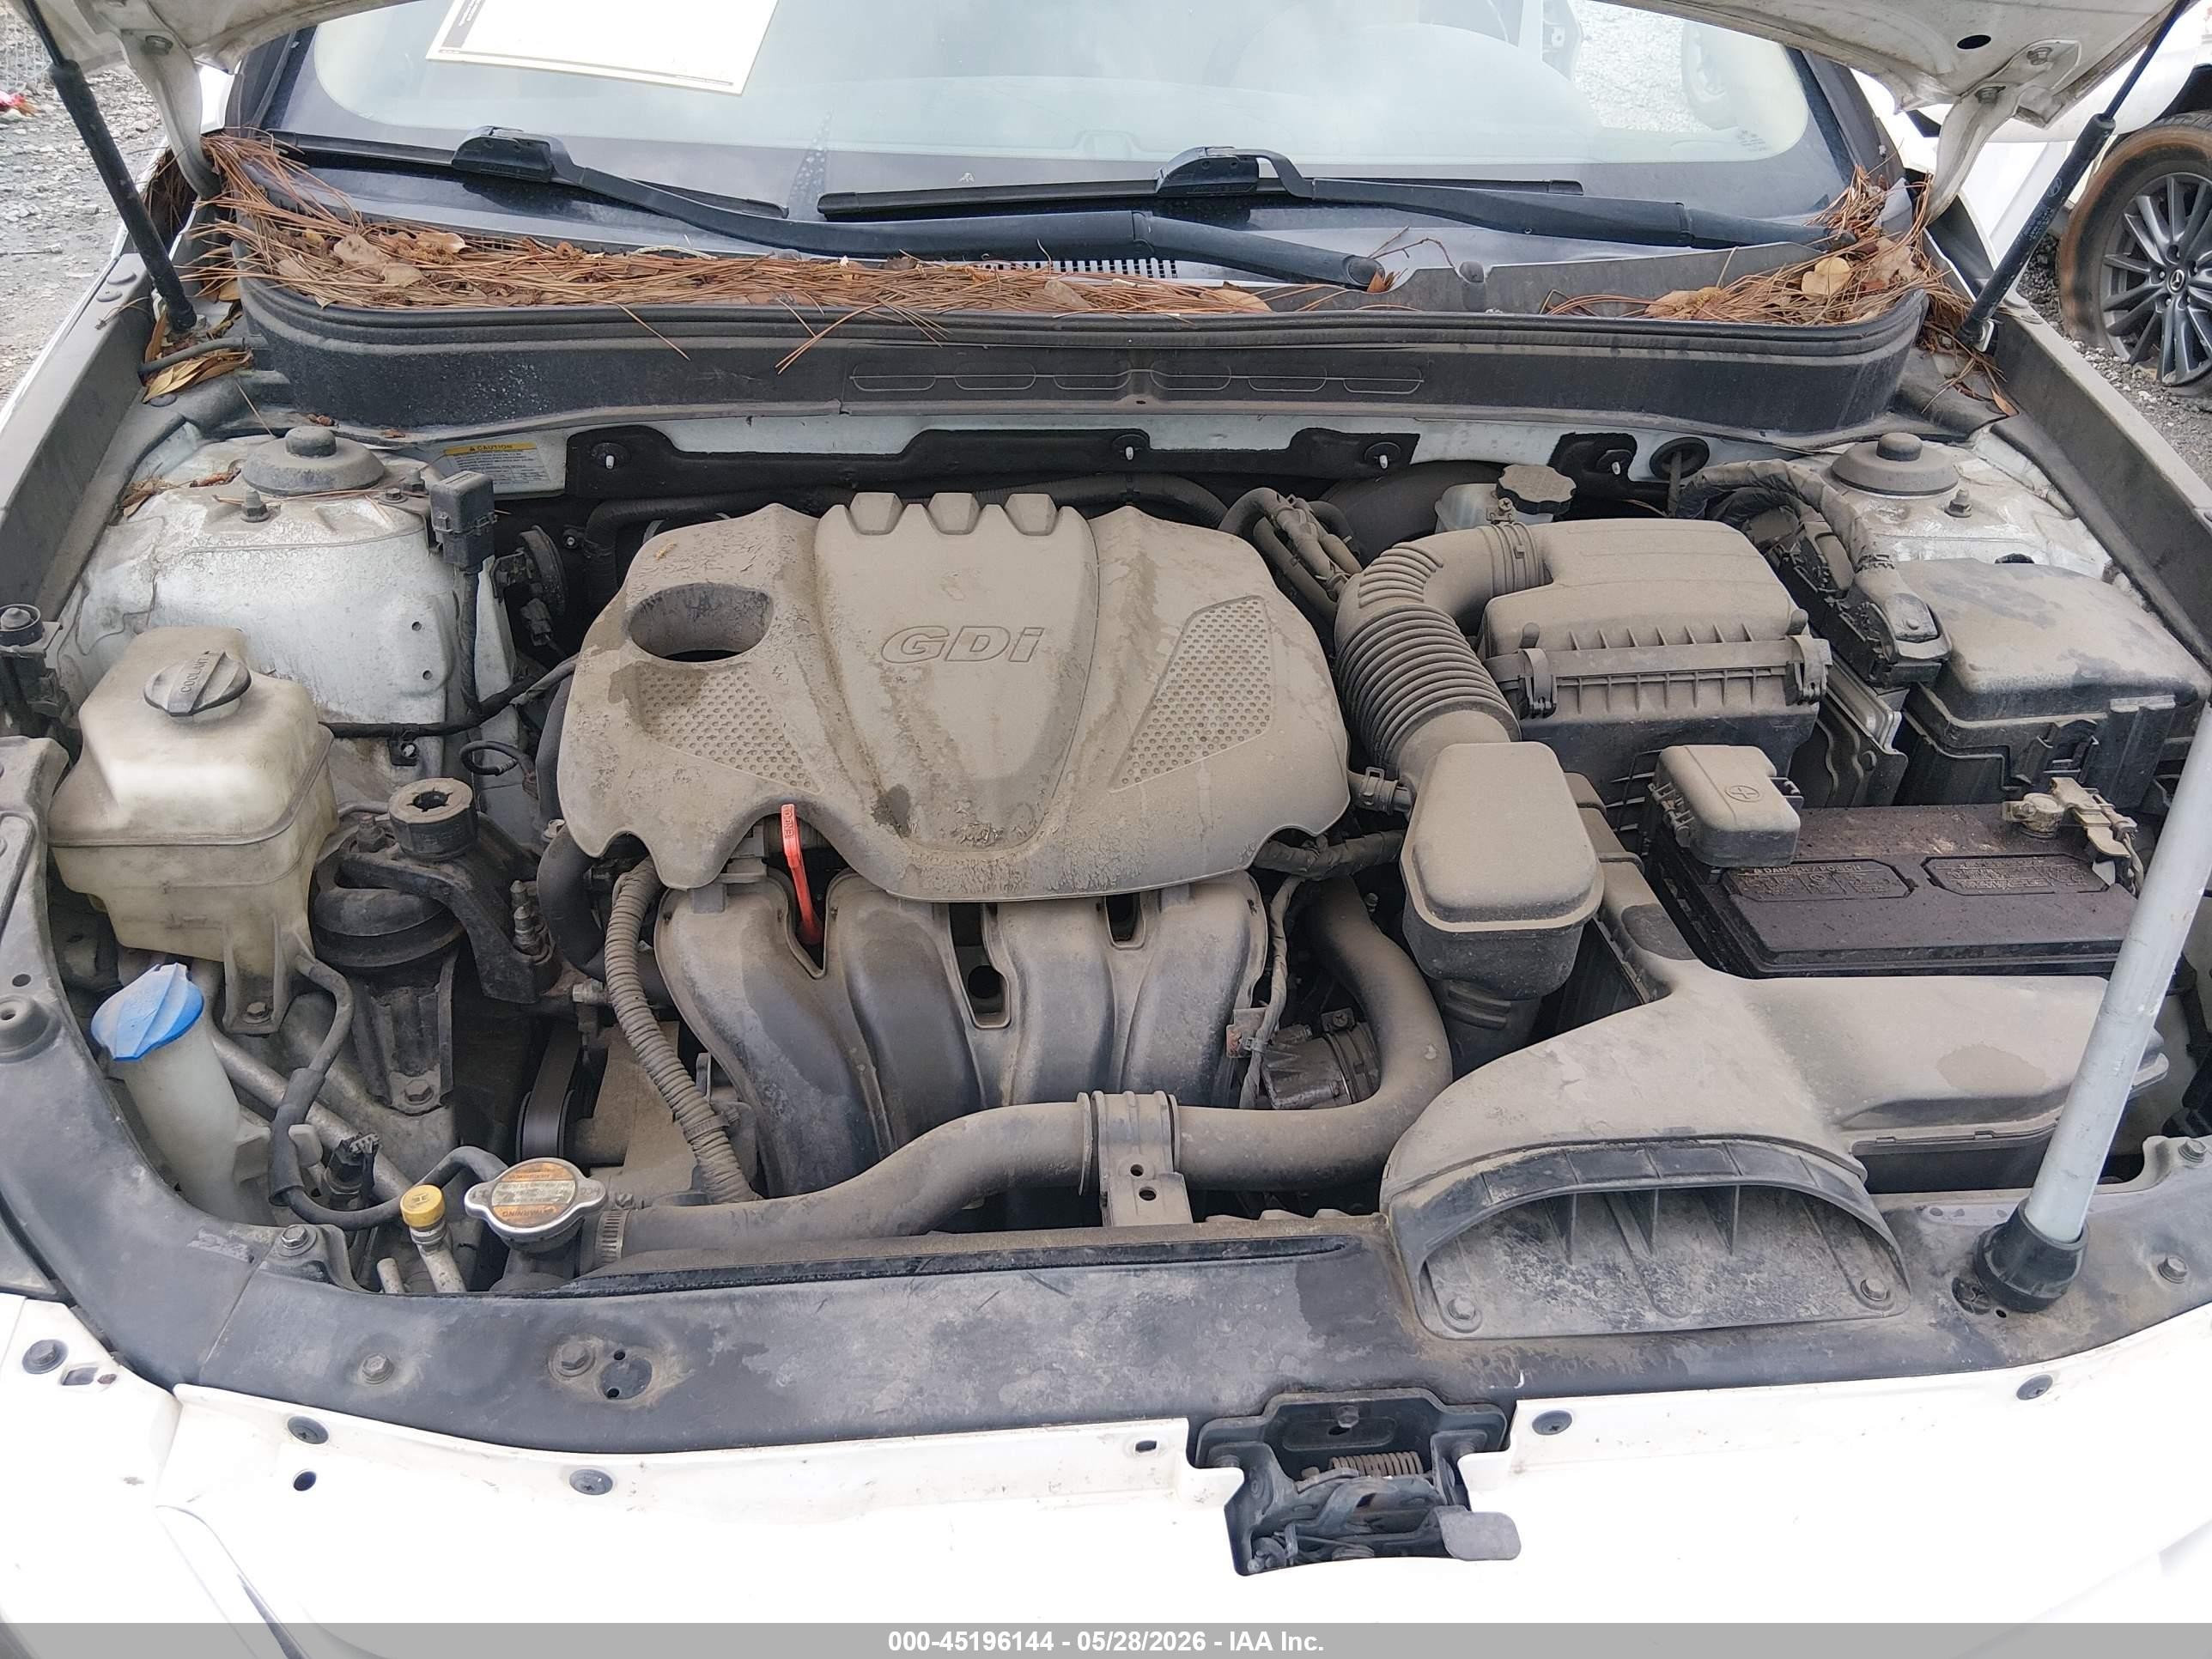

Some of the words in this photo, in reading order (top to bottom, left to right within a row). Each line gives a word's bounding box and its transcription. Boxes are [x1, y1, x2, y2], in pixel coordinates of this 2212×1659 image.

[881, 625, 1045, 664] GDi
[180, 655, 209, 693] COOLANT
[501, 1209, 544, 1218] WARNING
